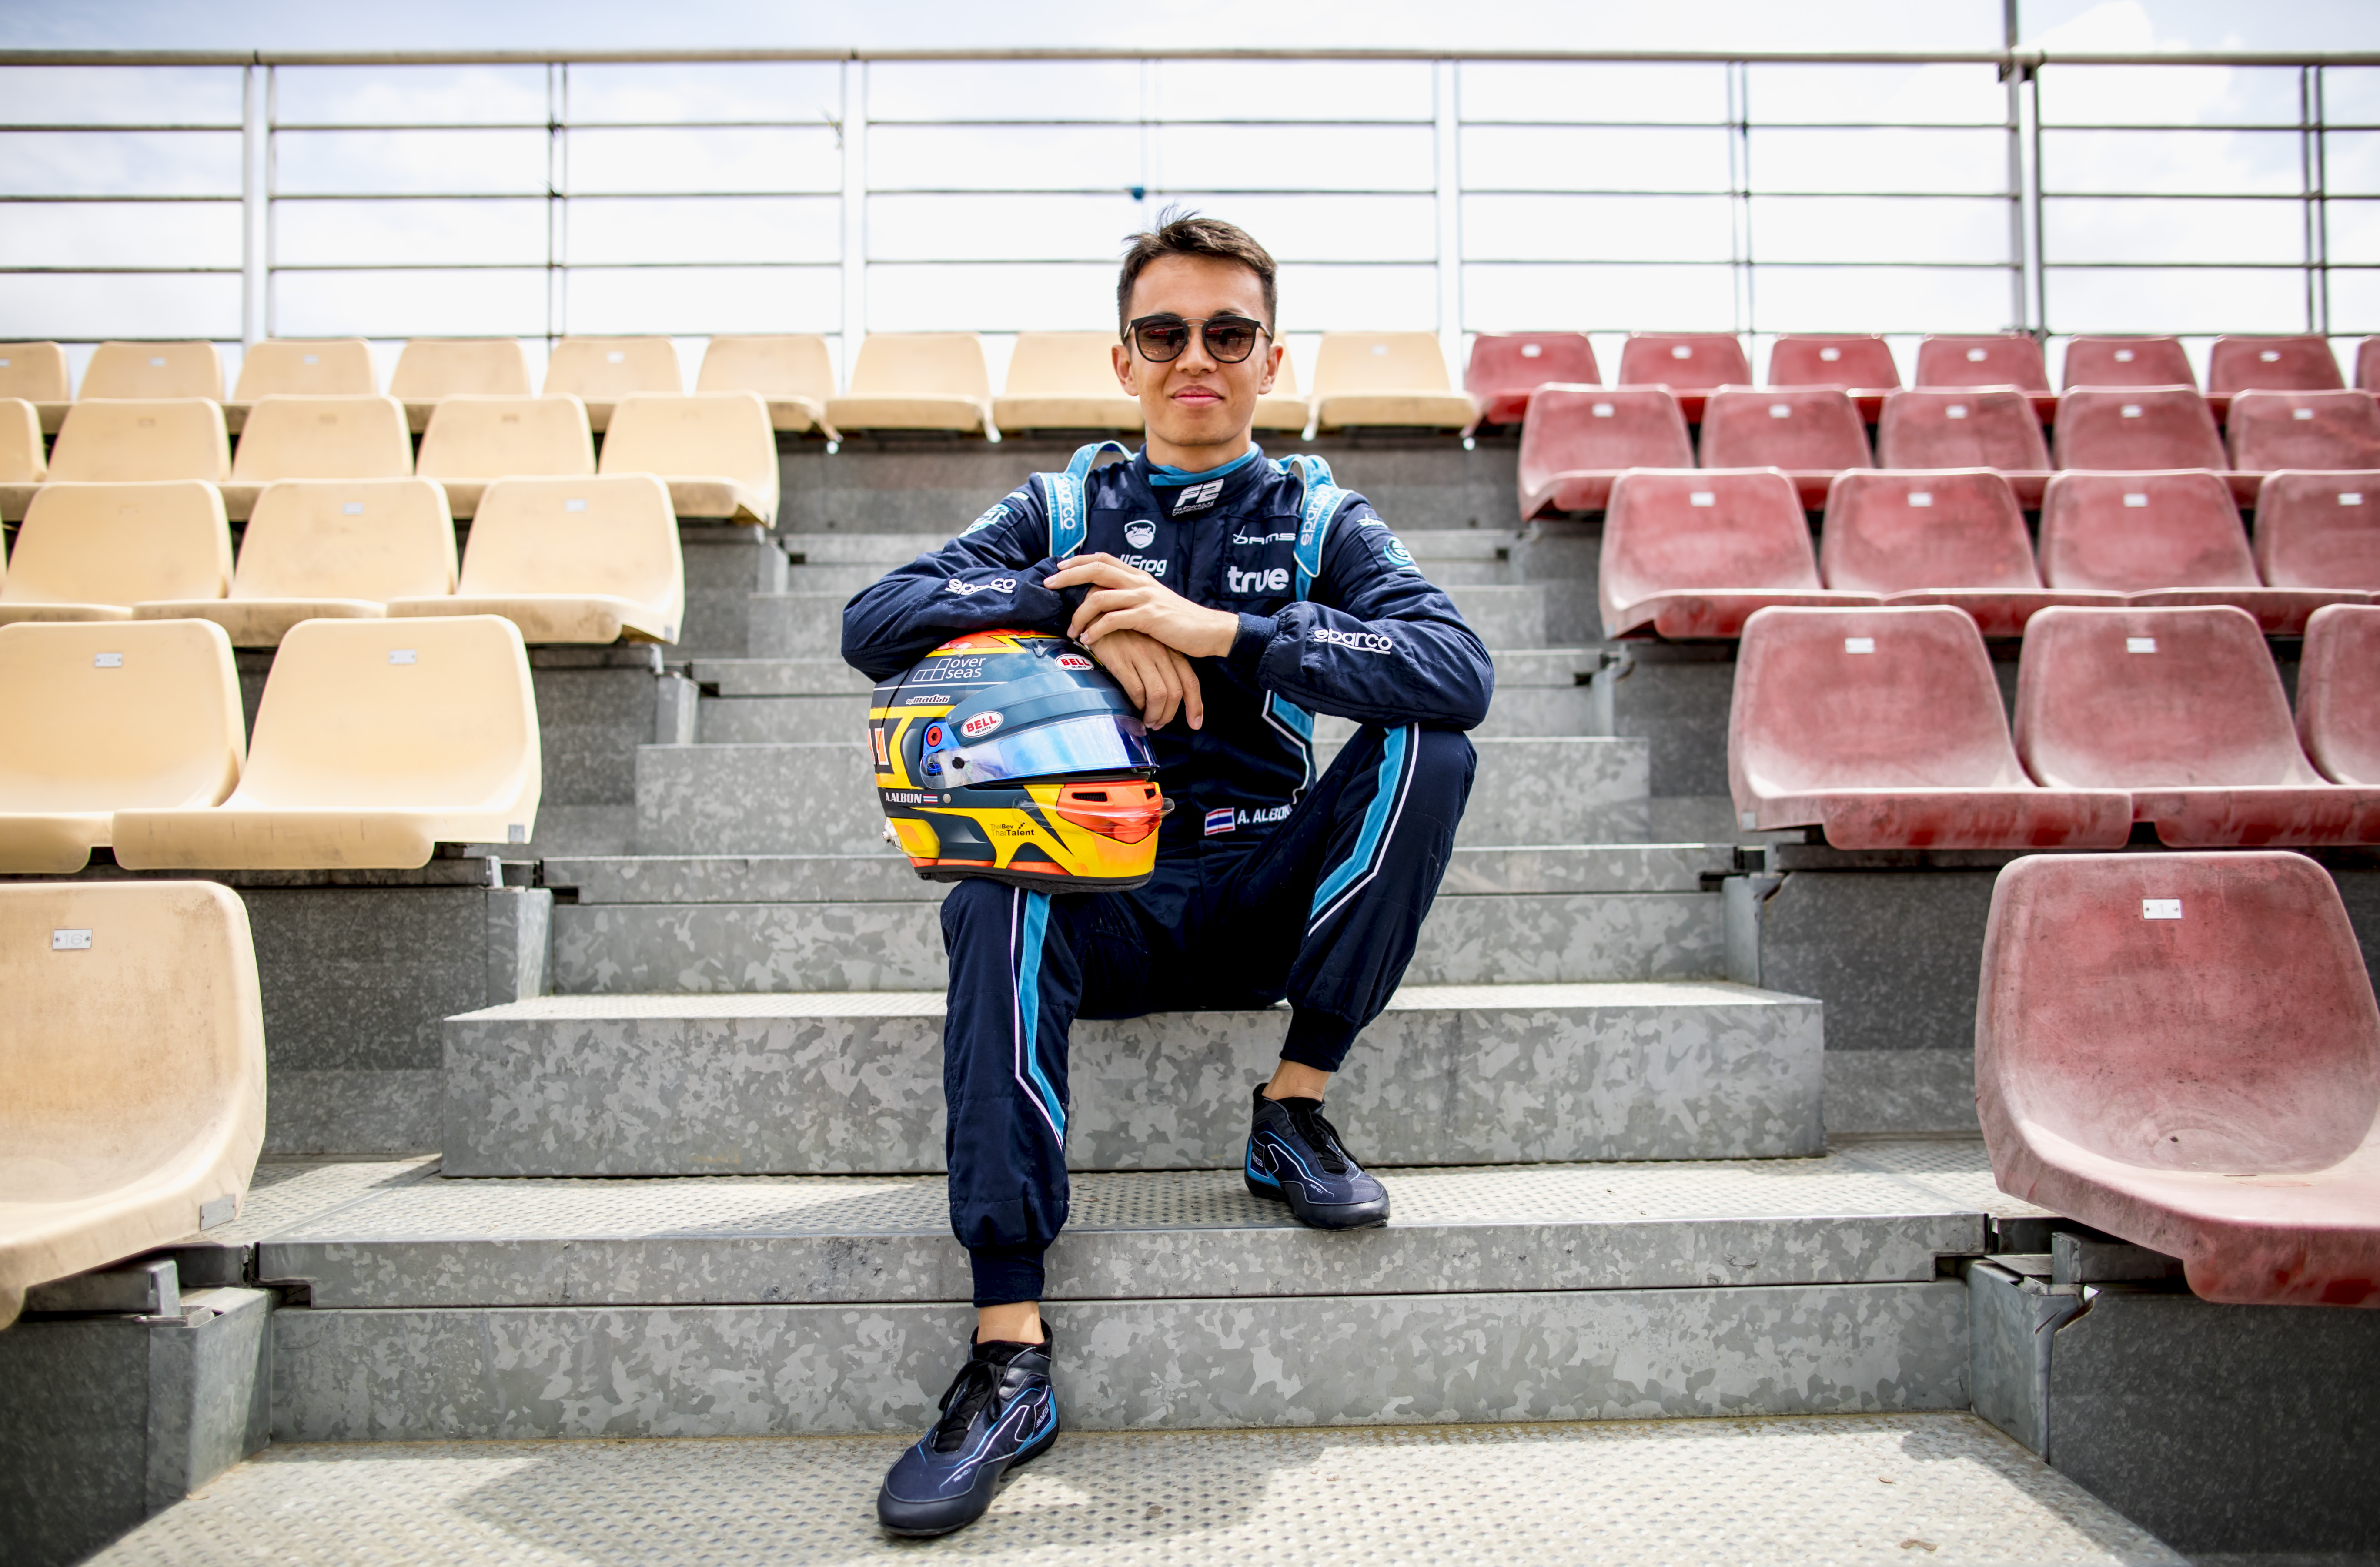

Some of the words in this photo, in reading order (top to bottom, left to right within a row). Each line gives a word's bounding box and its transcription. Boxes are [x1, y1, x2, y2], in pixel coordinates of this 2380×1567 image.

[1175, 479, 1224, 508] F2
[1300, 491, 1330, 546] sparco
[1227, 566, 1289, 593] true
[1313, 628, 1393, 655] sparco
[950, 658, 986, 668] over
[945, 668, 982, 679] seas
[913, 695, 950, 703] mad56
[966, 716, 997, 733] BELL
[1237, 810, 1250, 824] A.
[64, 934, 83, 945] 16
